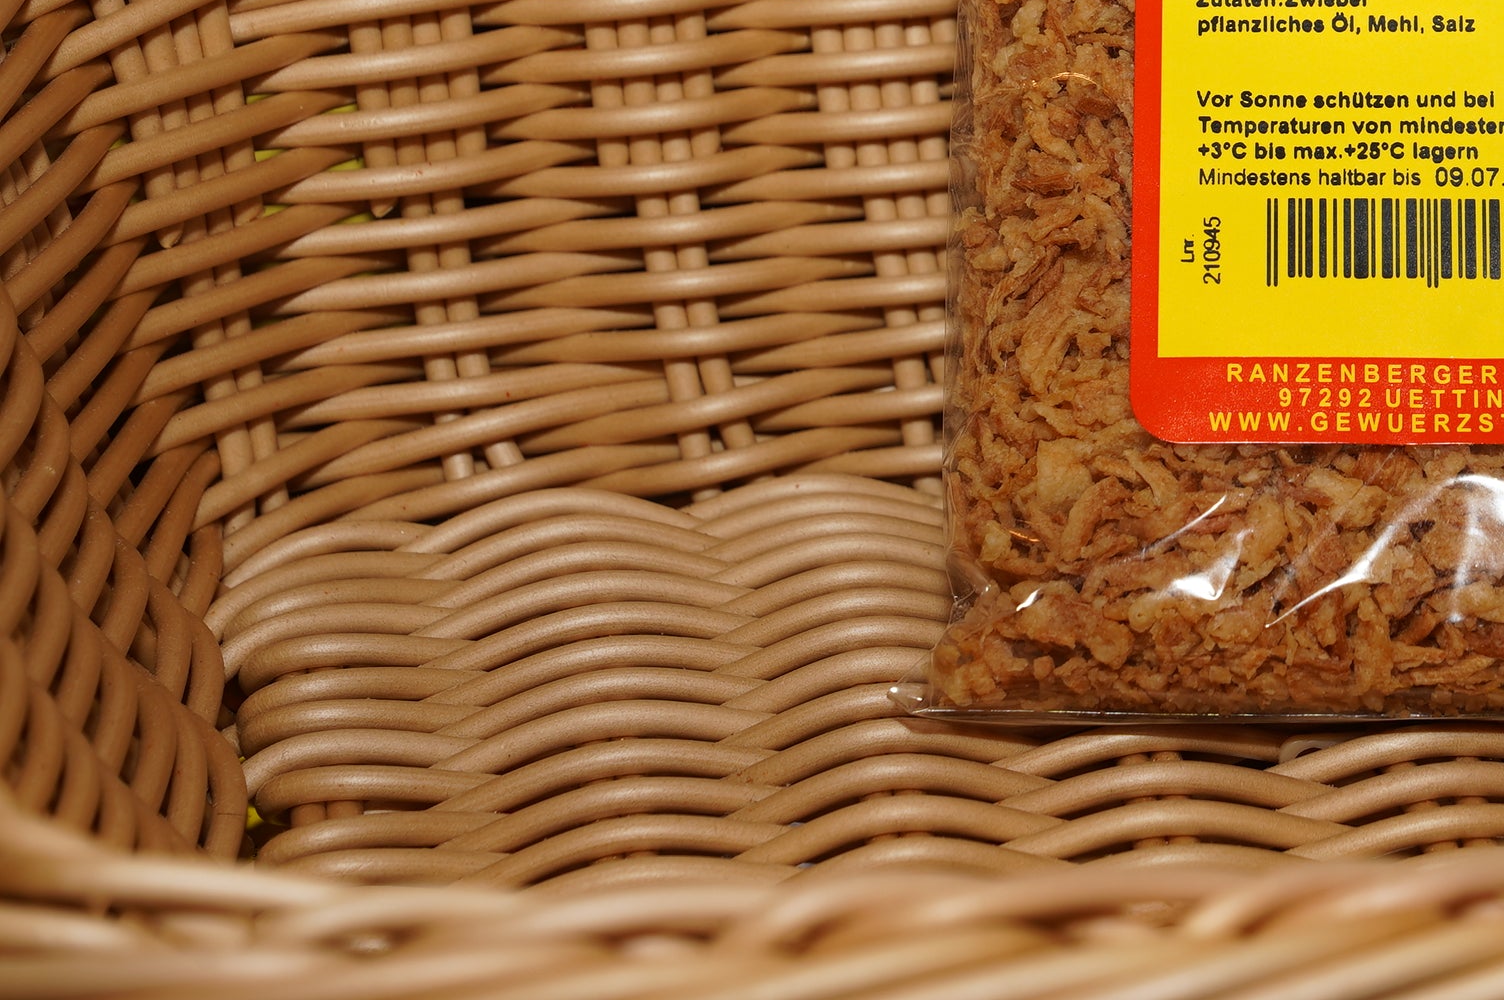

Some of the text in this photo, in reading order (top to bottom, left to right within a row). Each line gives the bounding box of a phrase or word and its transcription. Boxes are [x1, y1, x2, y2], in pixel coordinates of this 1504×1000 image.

[1197, 11, 1476, 35] pflanzliches Öl, Mehl, Salz
[1196, 90, 1495, 109] Vor Sonne schützen und bei
[1198, 115, 1345, 138] Temperaturen
[1352, 119, 1392, 135] von
[1197, 141, 1247, 160] +3°C
[1254, 142, 1286, 160] bis
[1413, 141, 1479, 162] lagern
[1199, 168, 1312, 186] Mindestens
[1318, 168, 1387, 186] haltbar
[1393, 168, 1421, 186] bis
[1202, 216, 1222, 285] 210945
[1226, 363, 1499, 387] RANZENBERGER
[1278, 387, 1373, 408] 97292
